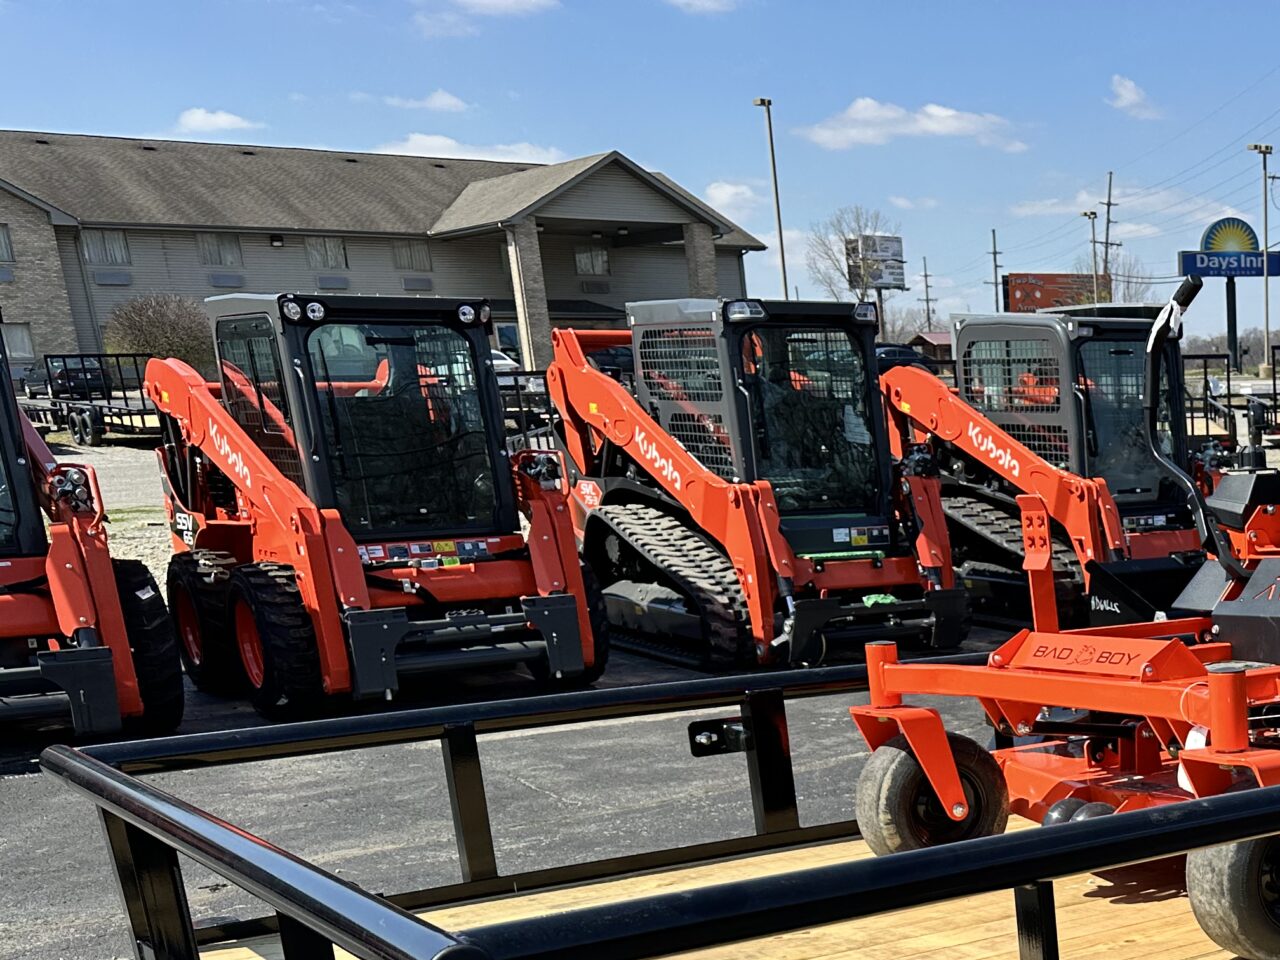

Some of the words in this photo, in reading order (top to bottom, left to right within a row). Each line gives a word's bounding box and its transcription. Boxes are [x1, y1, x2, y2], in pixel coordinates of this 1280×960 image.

[1195, 254, 1238, 269] Days
[208, 417, 252, 488] Kubota
[635, 425, 681, 491] Kubota
[968, 421, 1020, 477] Kubota
[580, 483, 597, 495] SVL
[176, 512, 193, 531] SSV
[183, 530, 194, 545] 65
[1033, 645, 1074, 660] BAD
[1095, 651, 1141, 666] BOY
